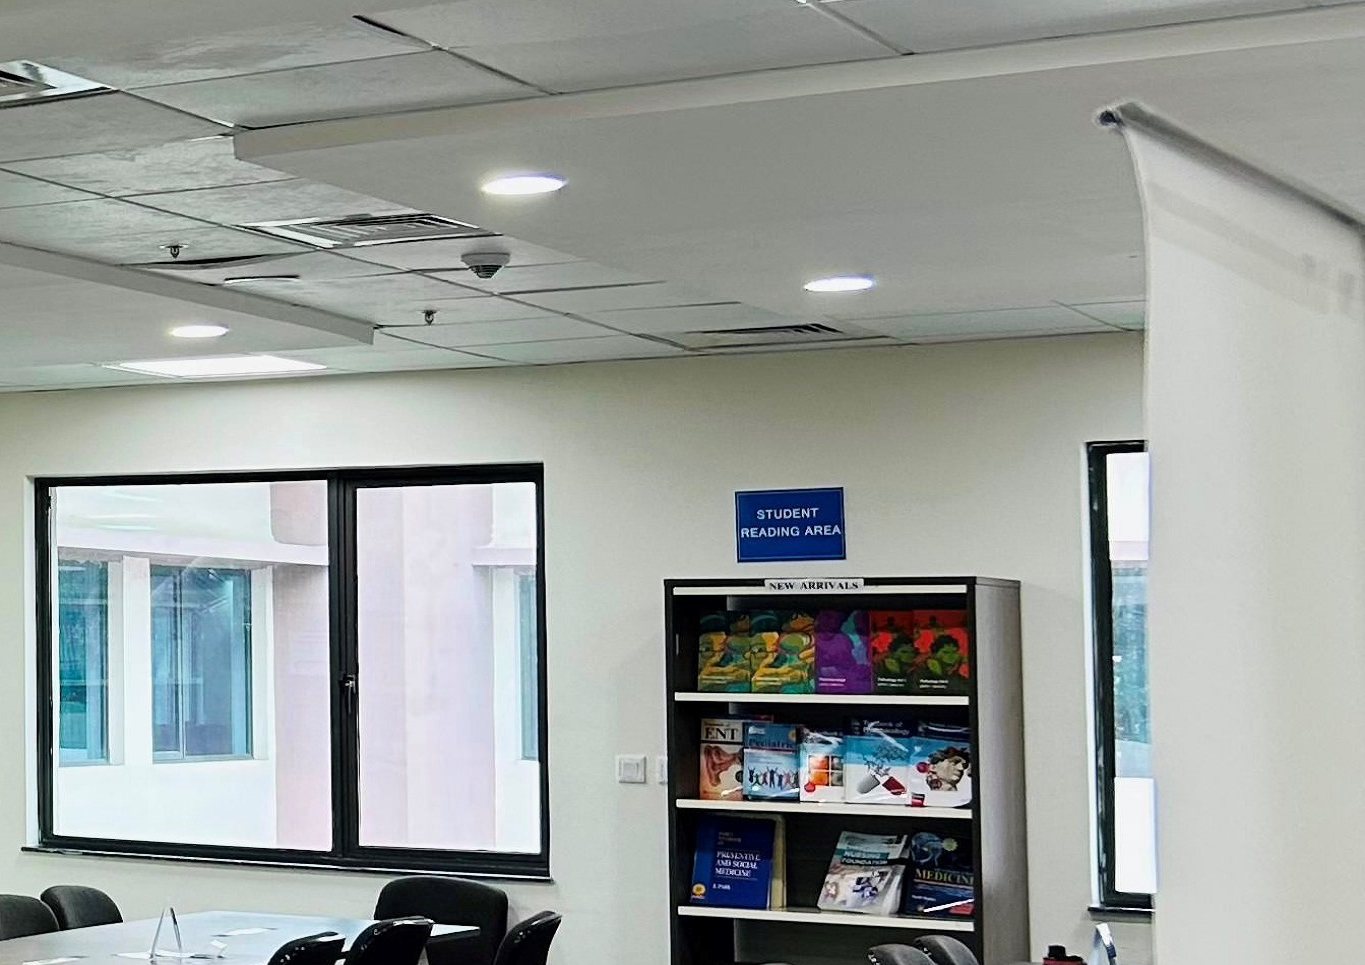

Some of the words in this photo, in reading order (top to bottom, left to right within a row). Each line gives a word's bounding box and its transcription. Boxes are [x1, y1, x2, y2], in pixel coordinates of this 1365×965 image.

[756, 507, 820, 520] STUDENT
[740, 526, 801, 539] READING
[804, 524, 842, 537] AREA
[769, 581, 796, 591] NEW
[800, 581, 860, 591] ARRIVALS
[704, 727, 739, 740] ENT
[715, 859, 732, 868] AND
[732, 860, 758, 870] SOCIAL
[714, 867, 752, 878] MEDICINE
